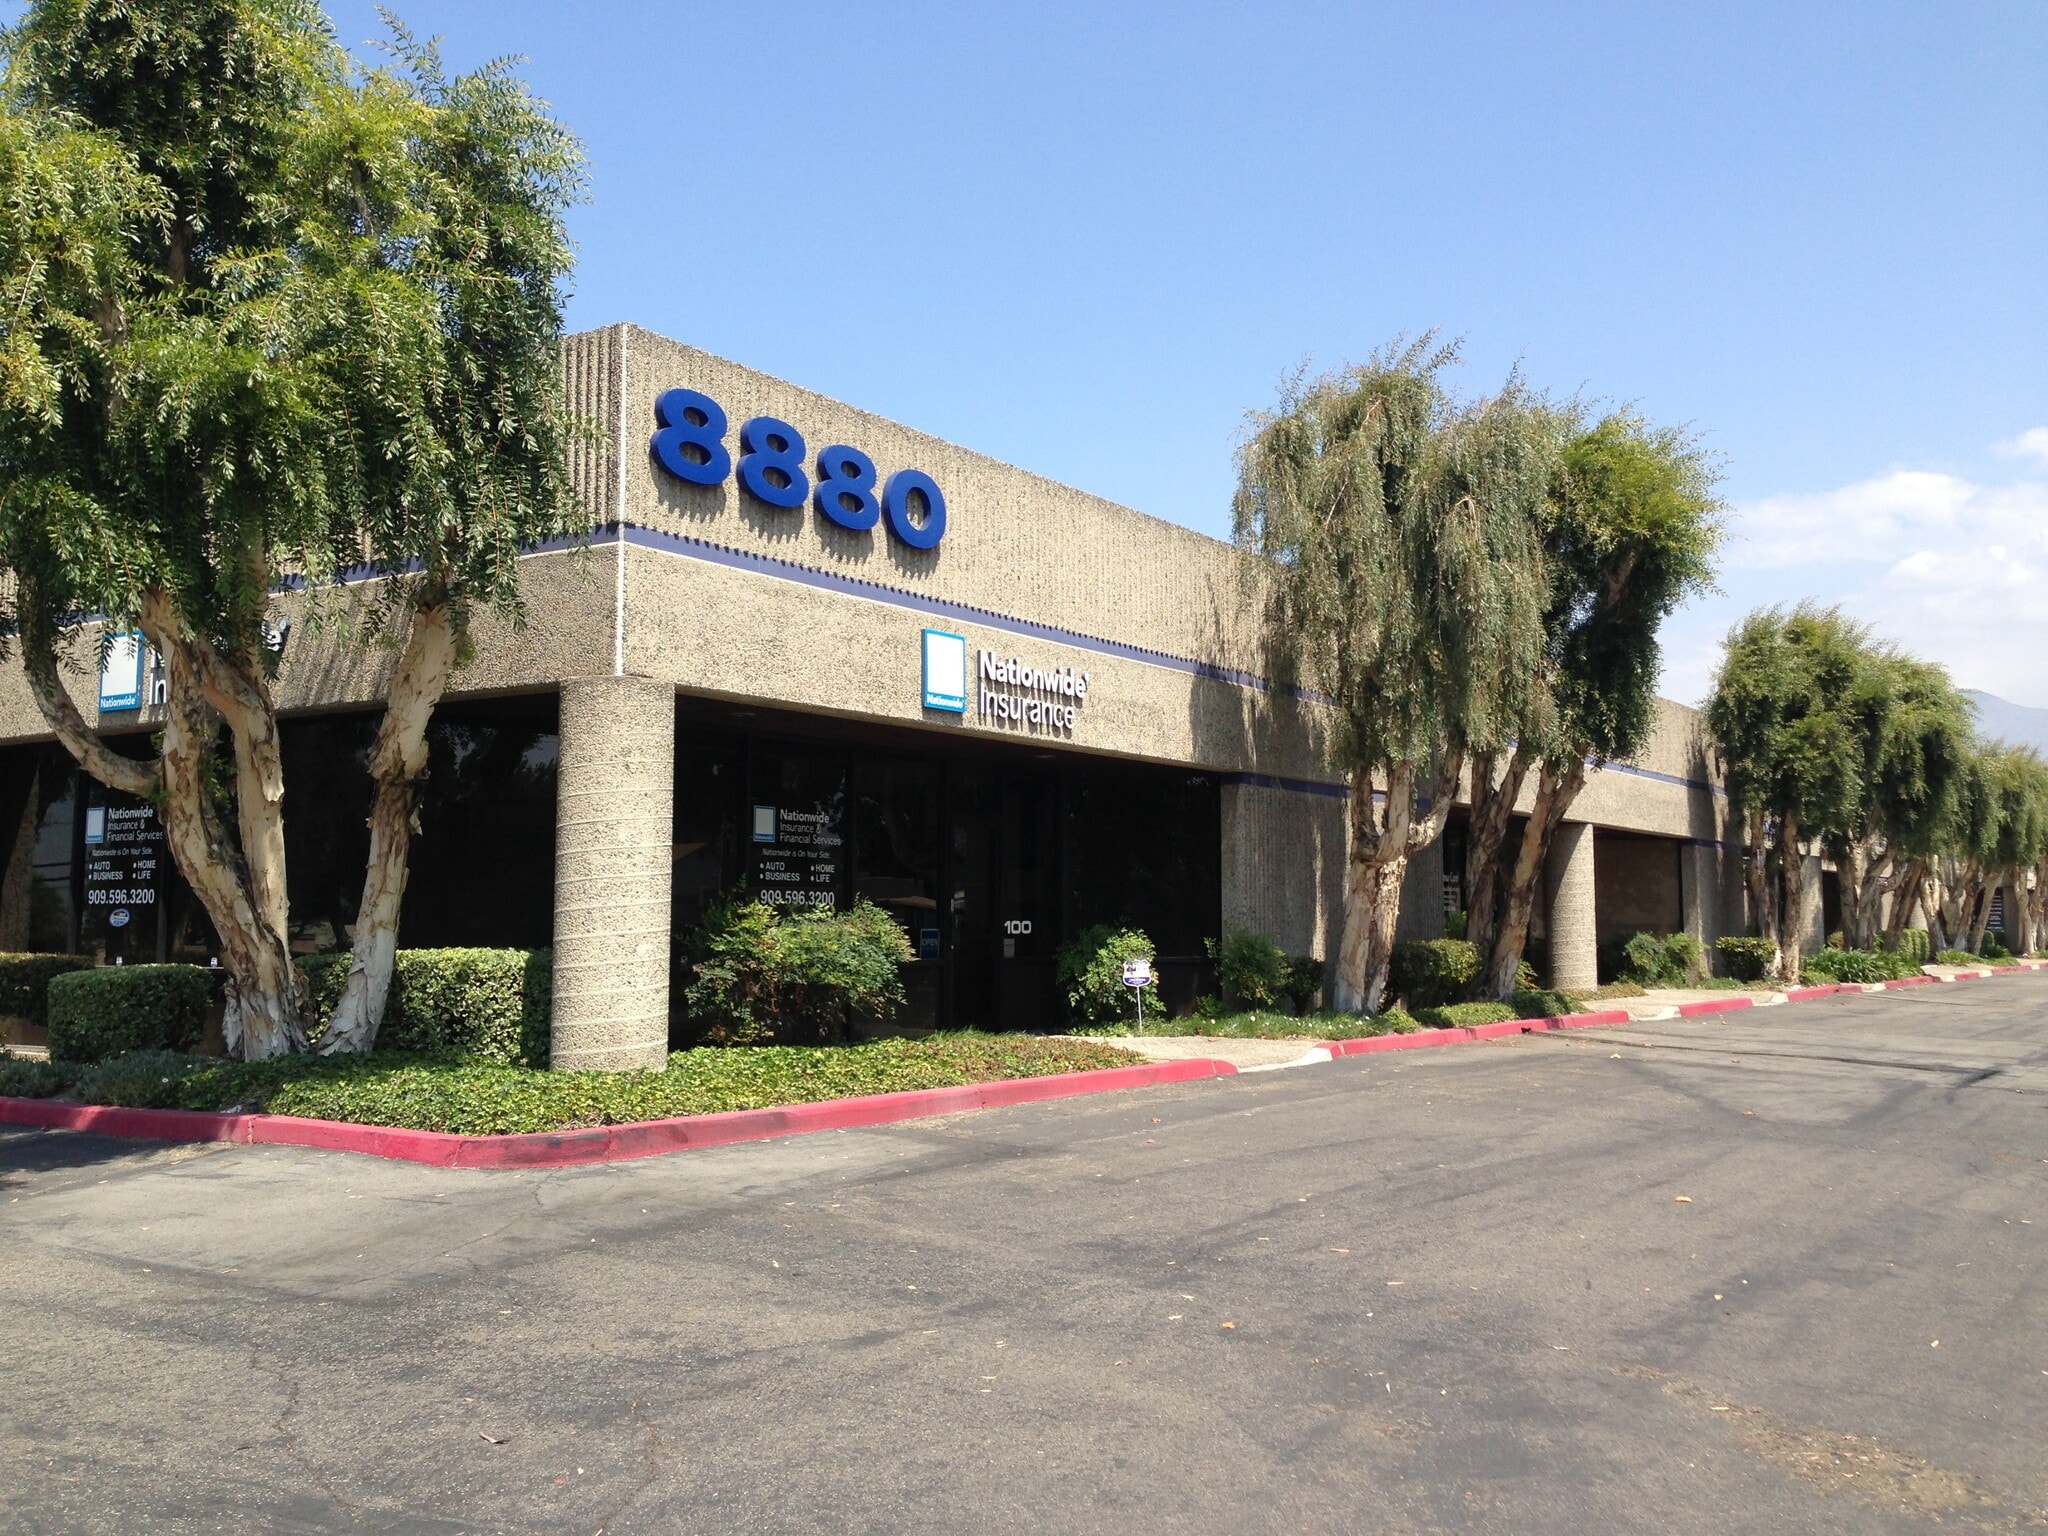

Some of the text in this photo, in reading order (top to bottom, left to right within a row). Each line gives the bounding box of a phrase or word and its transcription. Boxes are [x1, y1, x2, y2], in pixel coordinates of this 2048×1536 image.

[650, 388, 946, 549] 8880
[977, 649, 1087, 698] Nationwide
[100, 695, 137, 708] Nationwide
[926, 693, 965, 709] Nationwide
[977, 682, 1076, 729] Insurance
[108, 805, 154, 820] Nationwide
[780, 808, 830, 824] Nationwide
[107, 818, 145, 831] Insurance &
[780, 821, 814, 833] Insurance
[107, 831, 135, 842] Financial
[136, 830, 163, 840] Services
[780, 832, 811, 844] Financial
[812, 834, 842, 846] Services
[93, 859, 157, 870] AUTO HOME
[765, 861, 836, 873] AUTO HOME
[93, 870, 152, 881] BUSINESS LIFE
[765, 871, 831, 883] BUSINESS LIFE
[88, 888, 155, 905] 909.596.3200
[760, 889, 836, 907] 909.596.3200
[1004, 920, 1032, 935] 100
